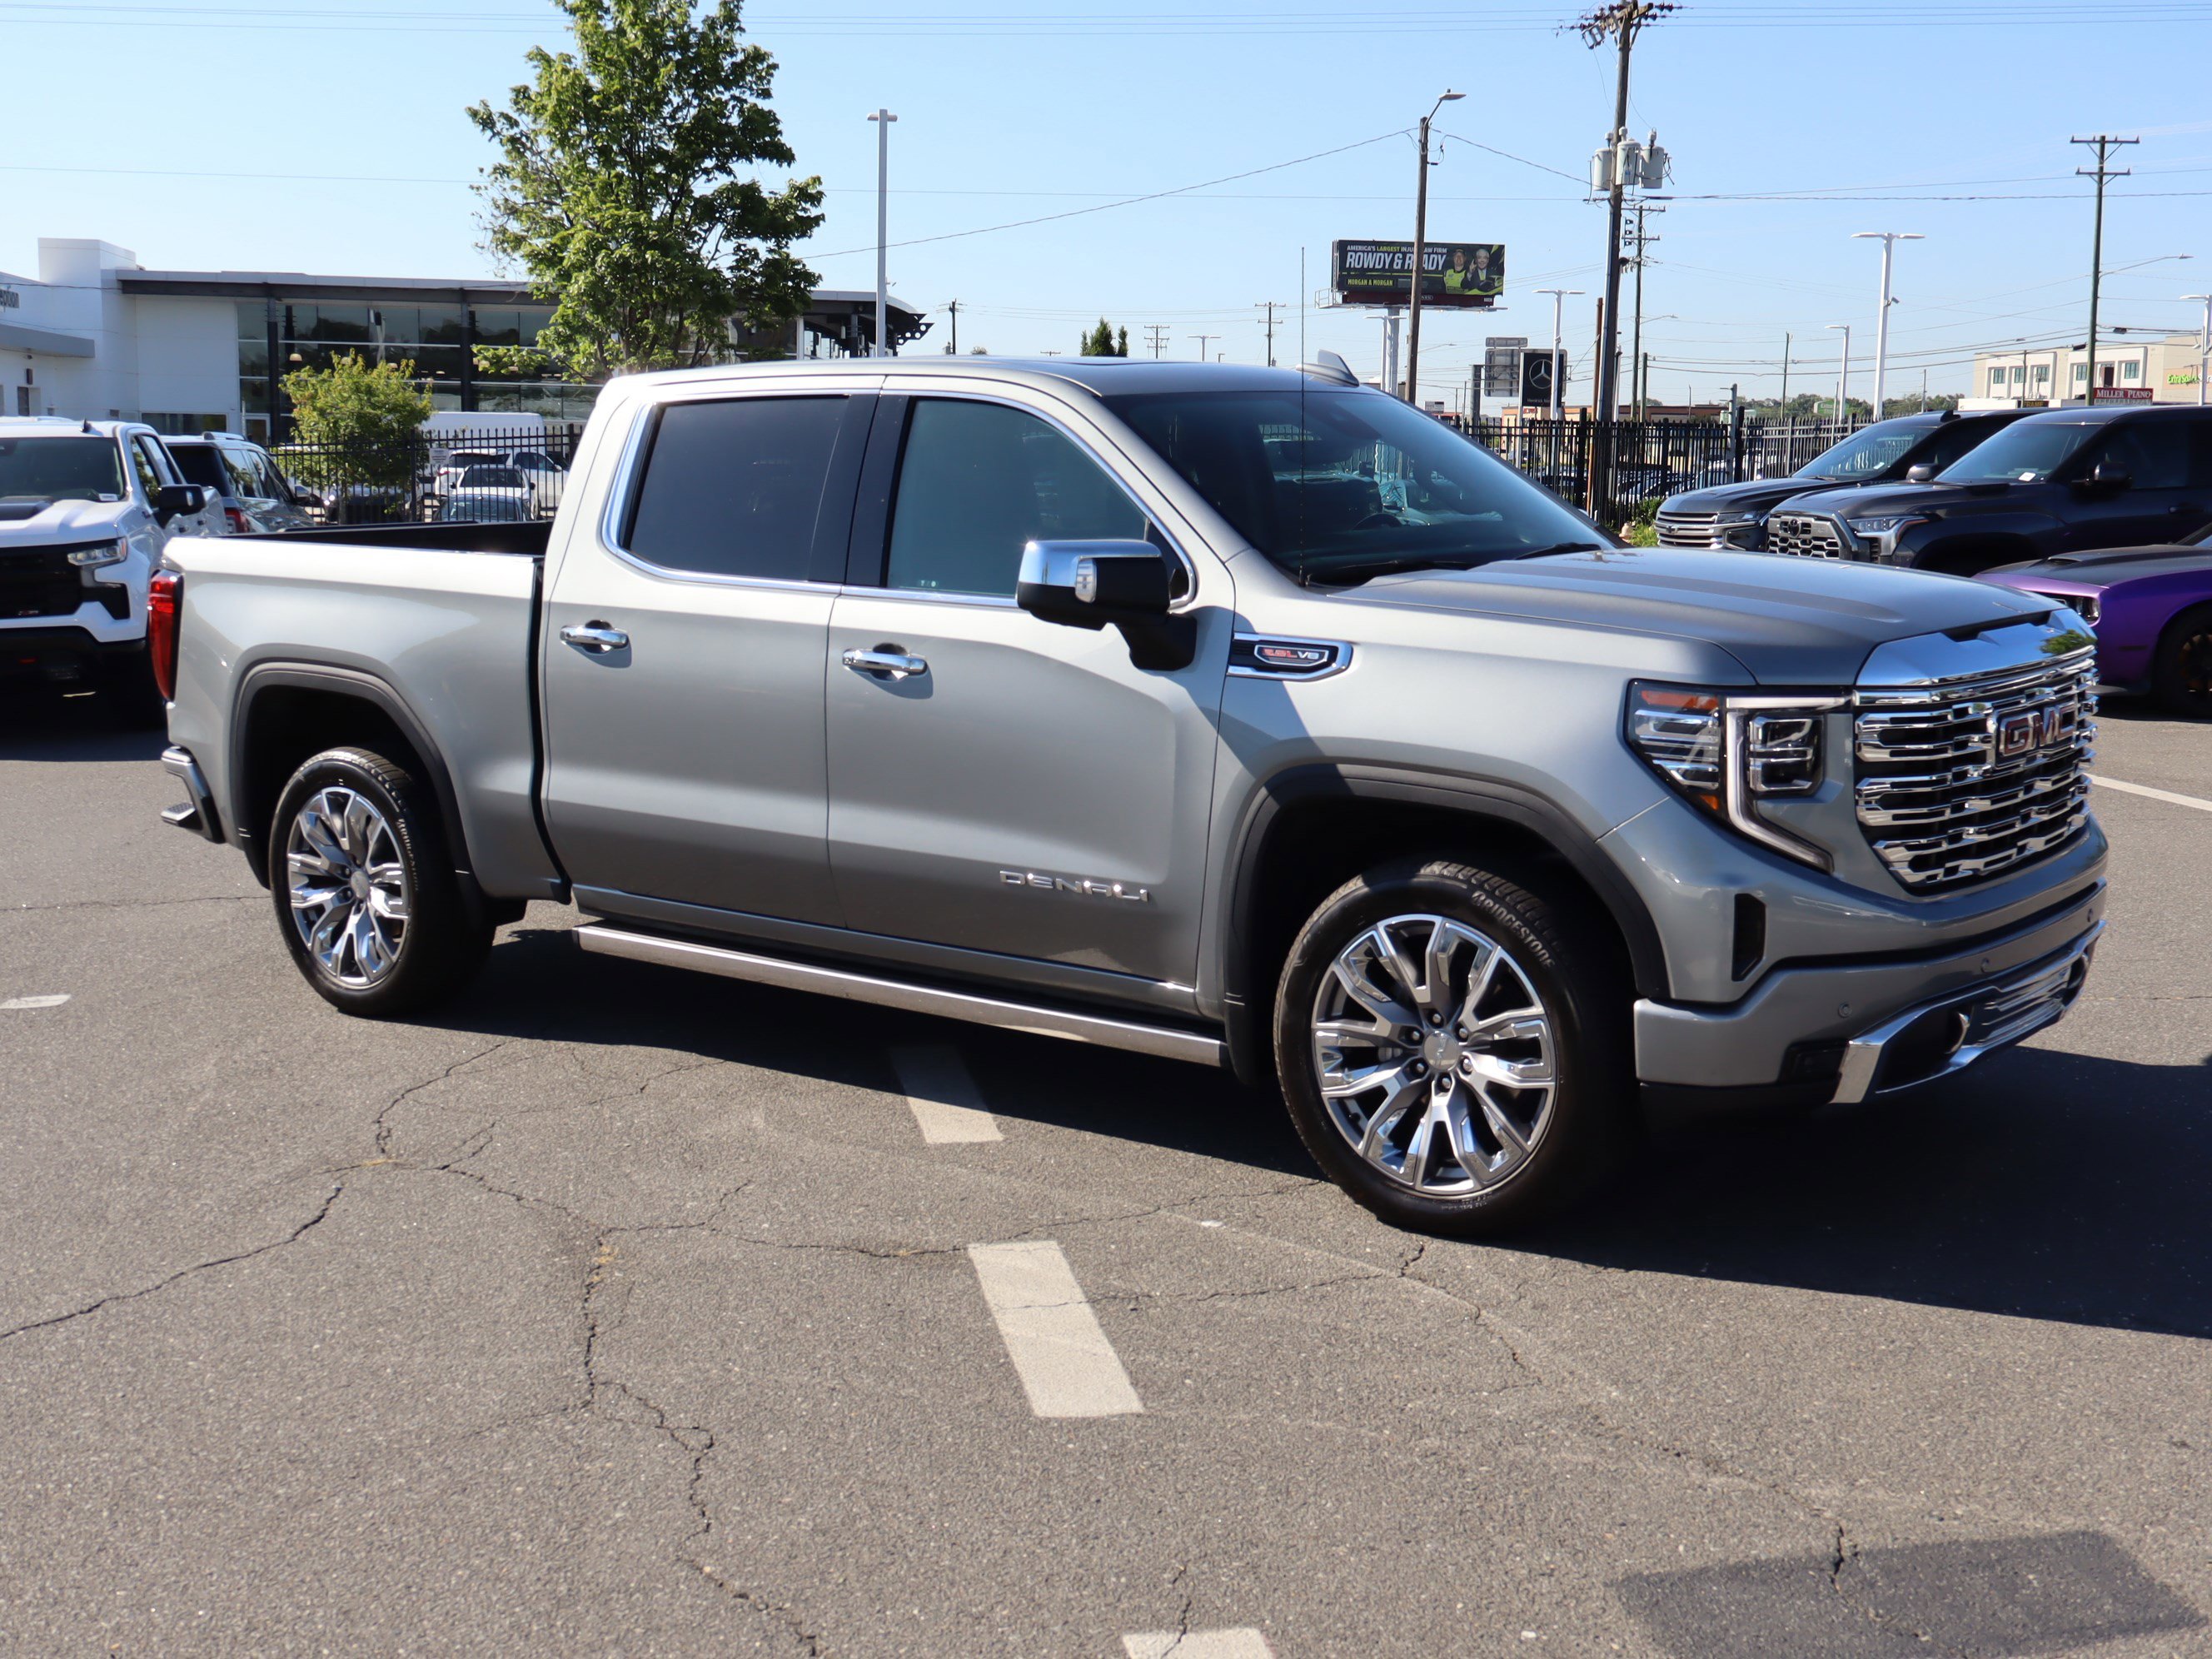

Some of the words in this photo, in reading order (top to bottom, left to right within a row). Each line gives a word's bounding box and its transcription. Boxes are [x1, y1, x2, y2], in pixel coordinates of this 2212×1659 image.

[1346, 252, 1393, 269] ROWDY
[1393, 252, 1403, 269] &
[1404, 253, 1447, 271] RADY
[2096, 389, 2124, 398] MILLER
[2128, 390, 2151, 398] PIANO
[1298, 650, 1319, 659] V8
[1999, 701, 2076, 756] GMC
[999, 870, 1148, 902] DENALI
[1472, 890, 1556, 968] BRIDGESTONE
